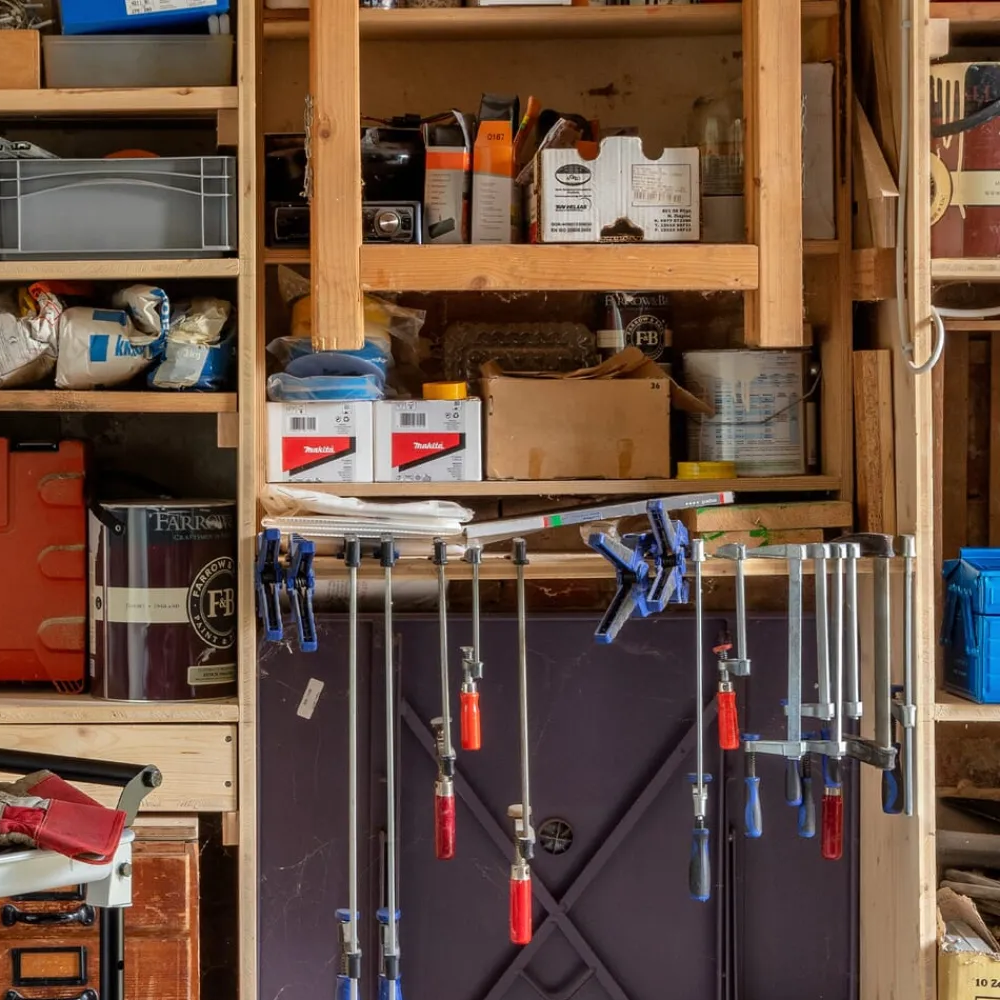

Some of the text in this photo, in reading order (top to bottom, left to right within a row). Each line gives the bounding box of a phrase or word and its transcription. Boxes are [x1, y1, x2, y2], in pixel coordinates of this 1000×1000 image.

[635, 330, 659, 346] F&B
[192, 559, 226, 598] FARROW
[975, 978, 989, 988] 10
